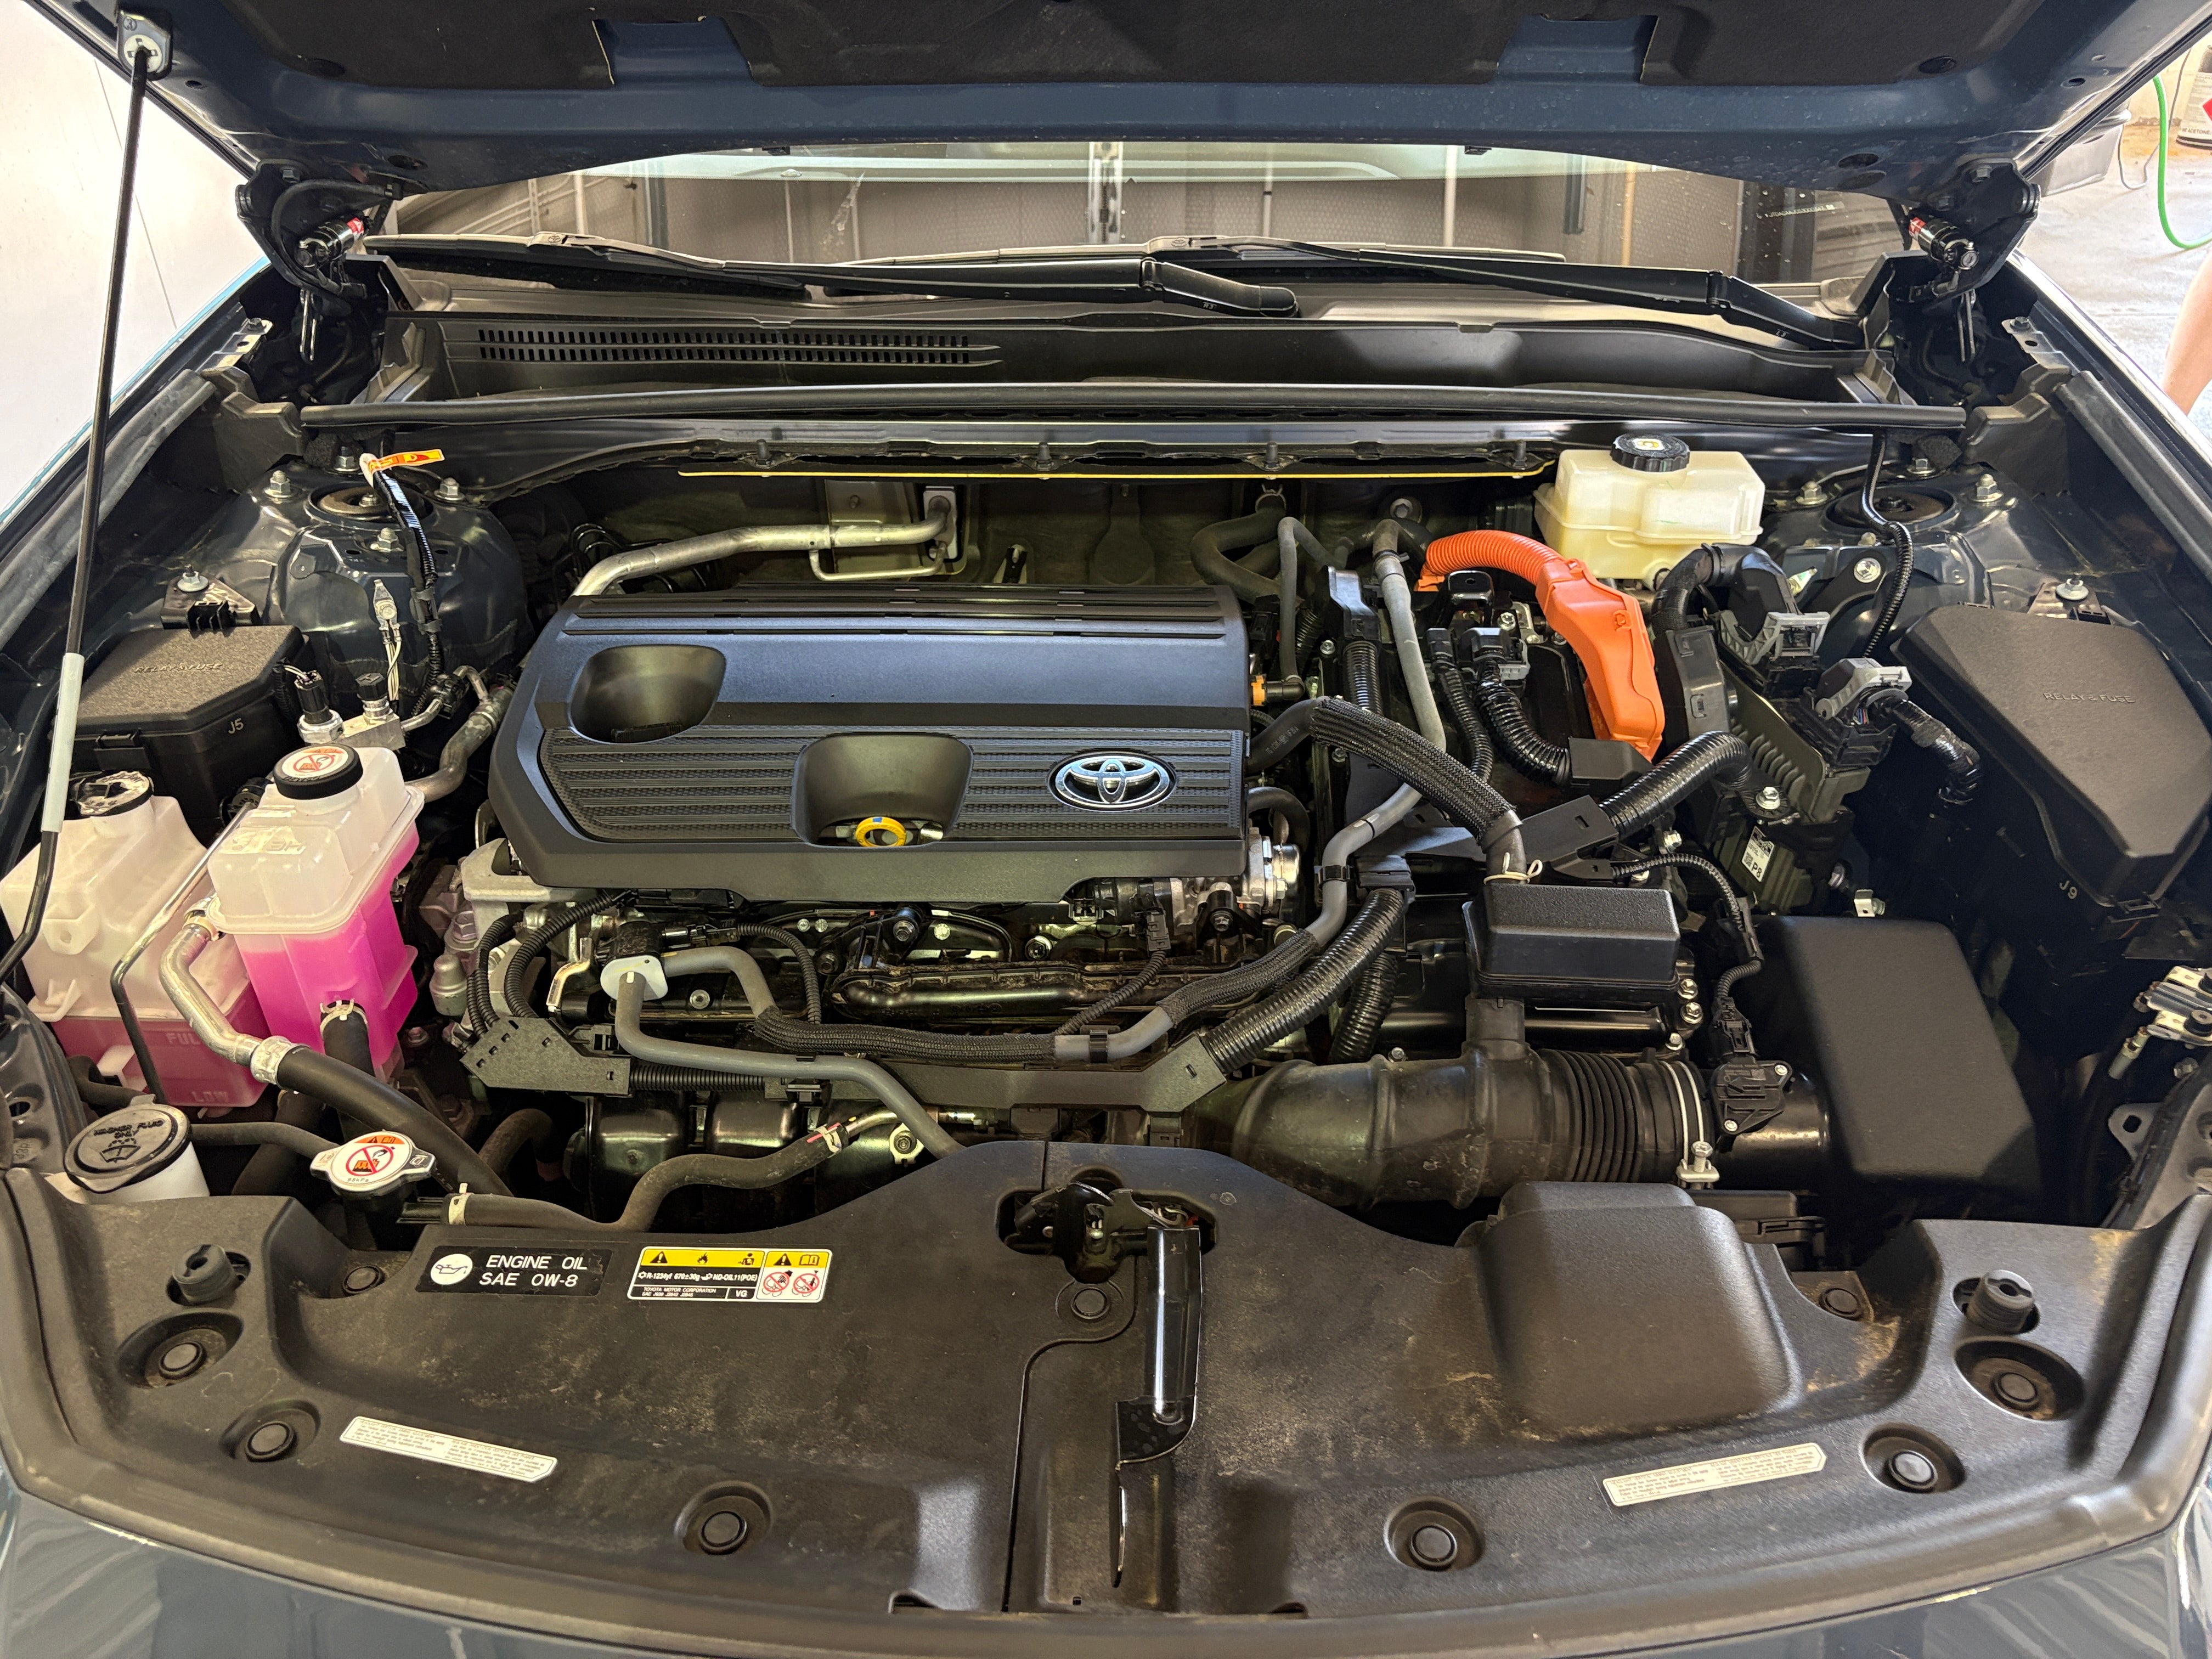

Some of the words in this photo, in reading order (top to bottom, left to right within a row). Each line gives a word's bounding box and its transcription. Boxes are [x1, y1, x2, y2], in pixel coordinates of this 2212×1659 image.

[134, 665, 177, 673] RELAY
[2099, 695, 2135, 703] FUSE
[228, 718, 244, 734] J5
[1751, 862, 1763, 878] P8
[2059, 880, 2078, 900] J9
[137, 1120, 164, 1129] FLUID
[486, 1255, 552, 1269] ENGINE
[562, 1256, 588, 1270] OIL
[479, 1272, 520, 1286] SAE
[531, 1273, 579, 1288] 0W-8
[646, 1272, 673, 1281] R-1234yf
[674, 1273, 701, 1282] 670±30g
[713, 1273, 758, 1282] ND-OIL11(POE)
